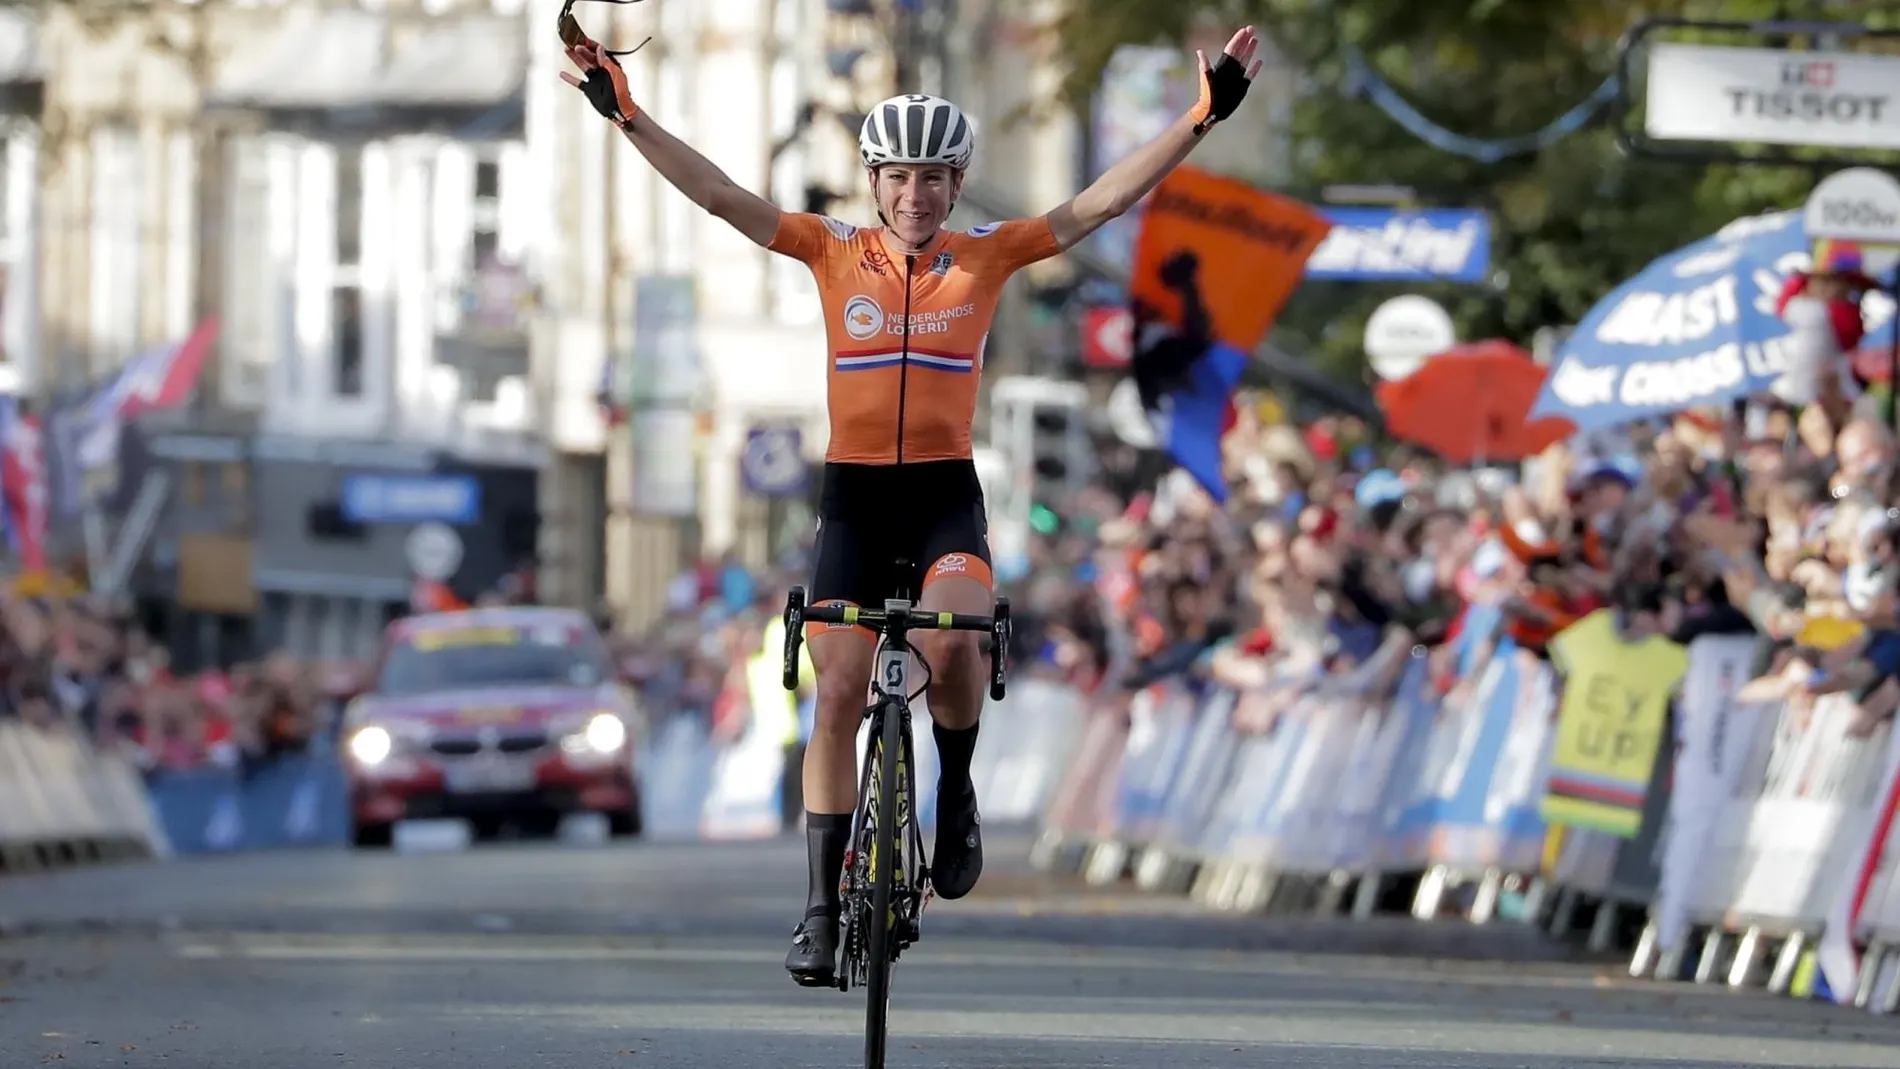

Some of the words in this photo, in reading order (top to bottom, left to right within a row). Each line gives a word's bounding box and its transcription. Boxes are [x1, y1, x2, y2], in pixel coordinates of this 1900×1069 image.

[1724, 89, 1889, 123] TISSOT
[887, 303, 974, 324] NEDERLANDSE
[886, 320, 948, 335] LOTERIJ
